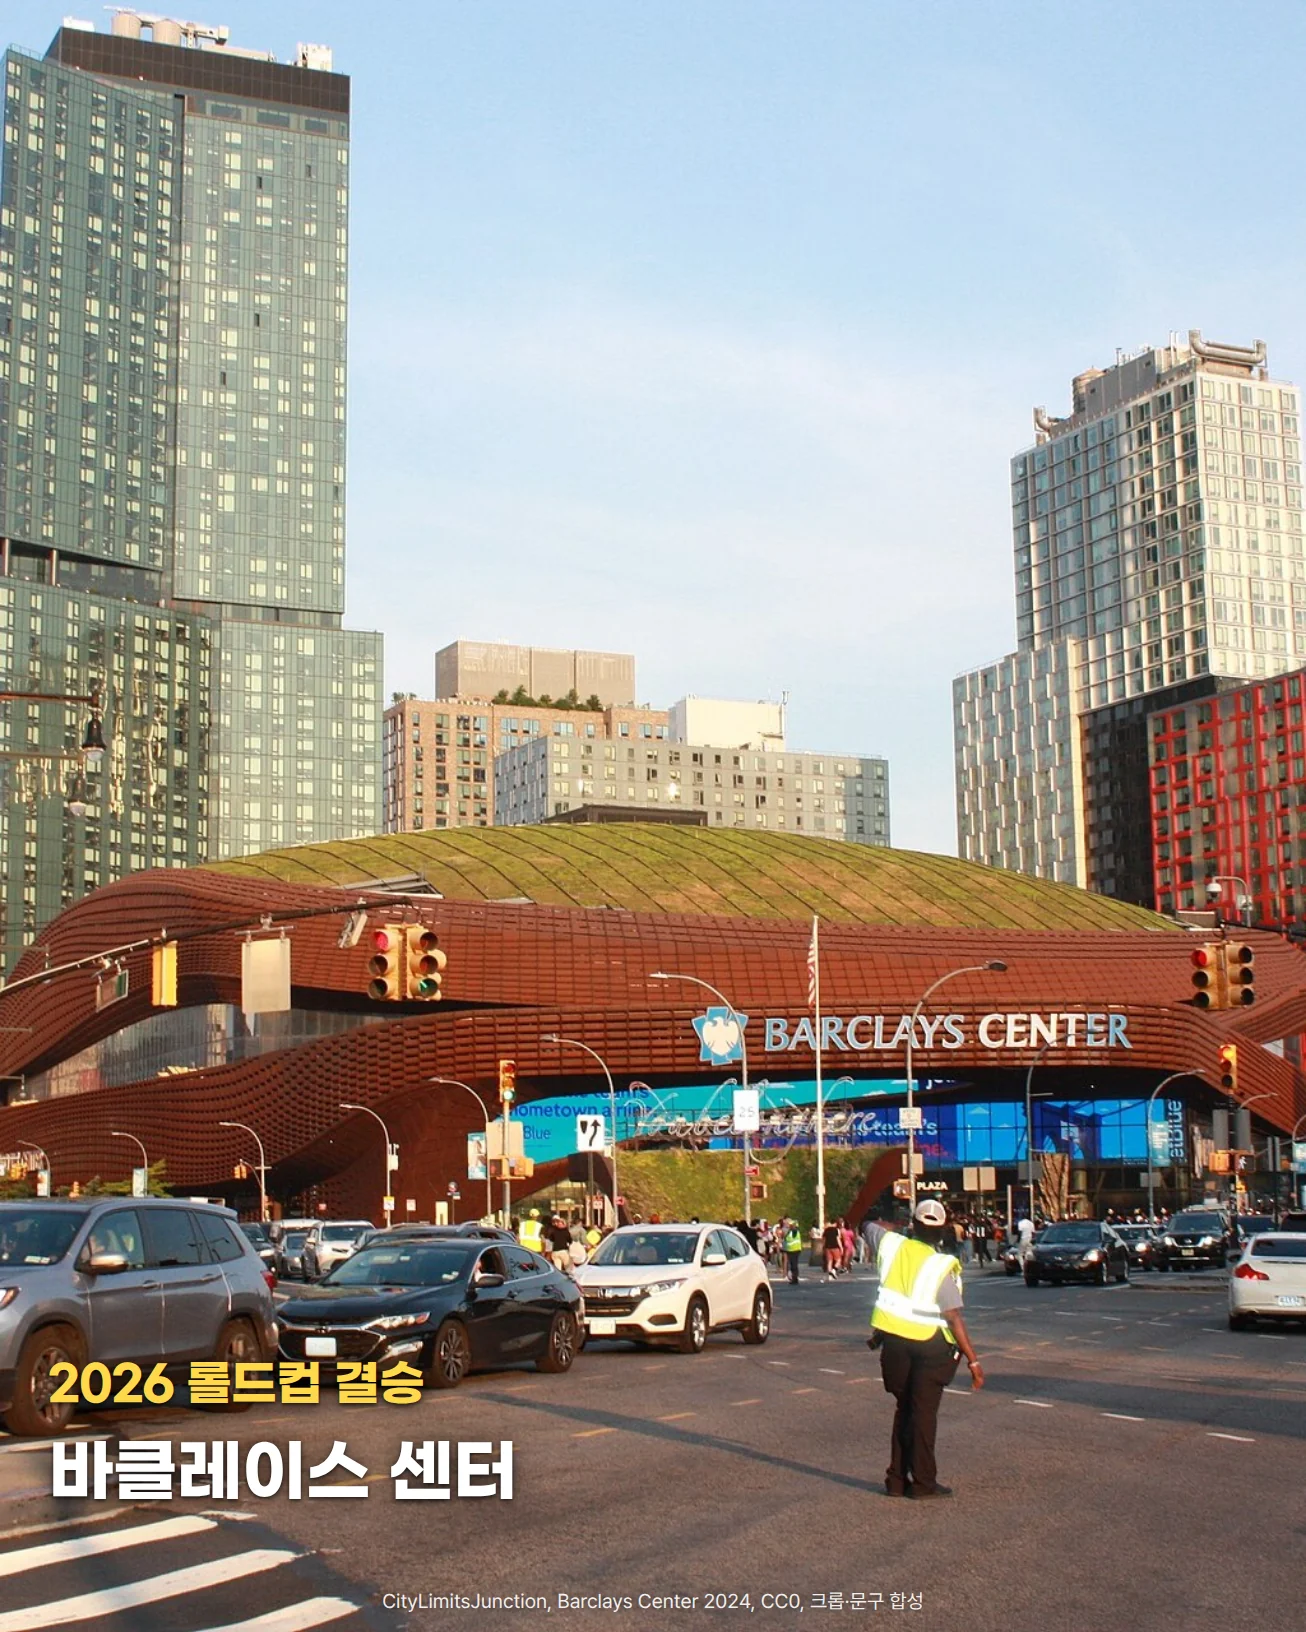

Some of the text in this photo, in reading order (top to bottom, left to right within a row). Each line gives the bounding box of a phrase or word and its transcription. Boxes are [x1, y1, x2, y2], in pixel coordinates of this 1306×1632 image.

[764, 1013, 1133, 1051] BARCLAYS CENTER
[738, 1106, 755, 1118] 25
[916, 1182, 948, 1191] PLAZA
